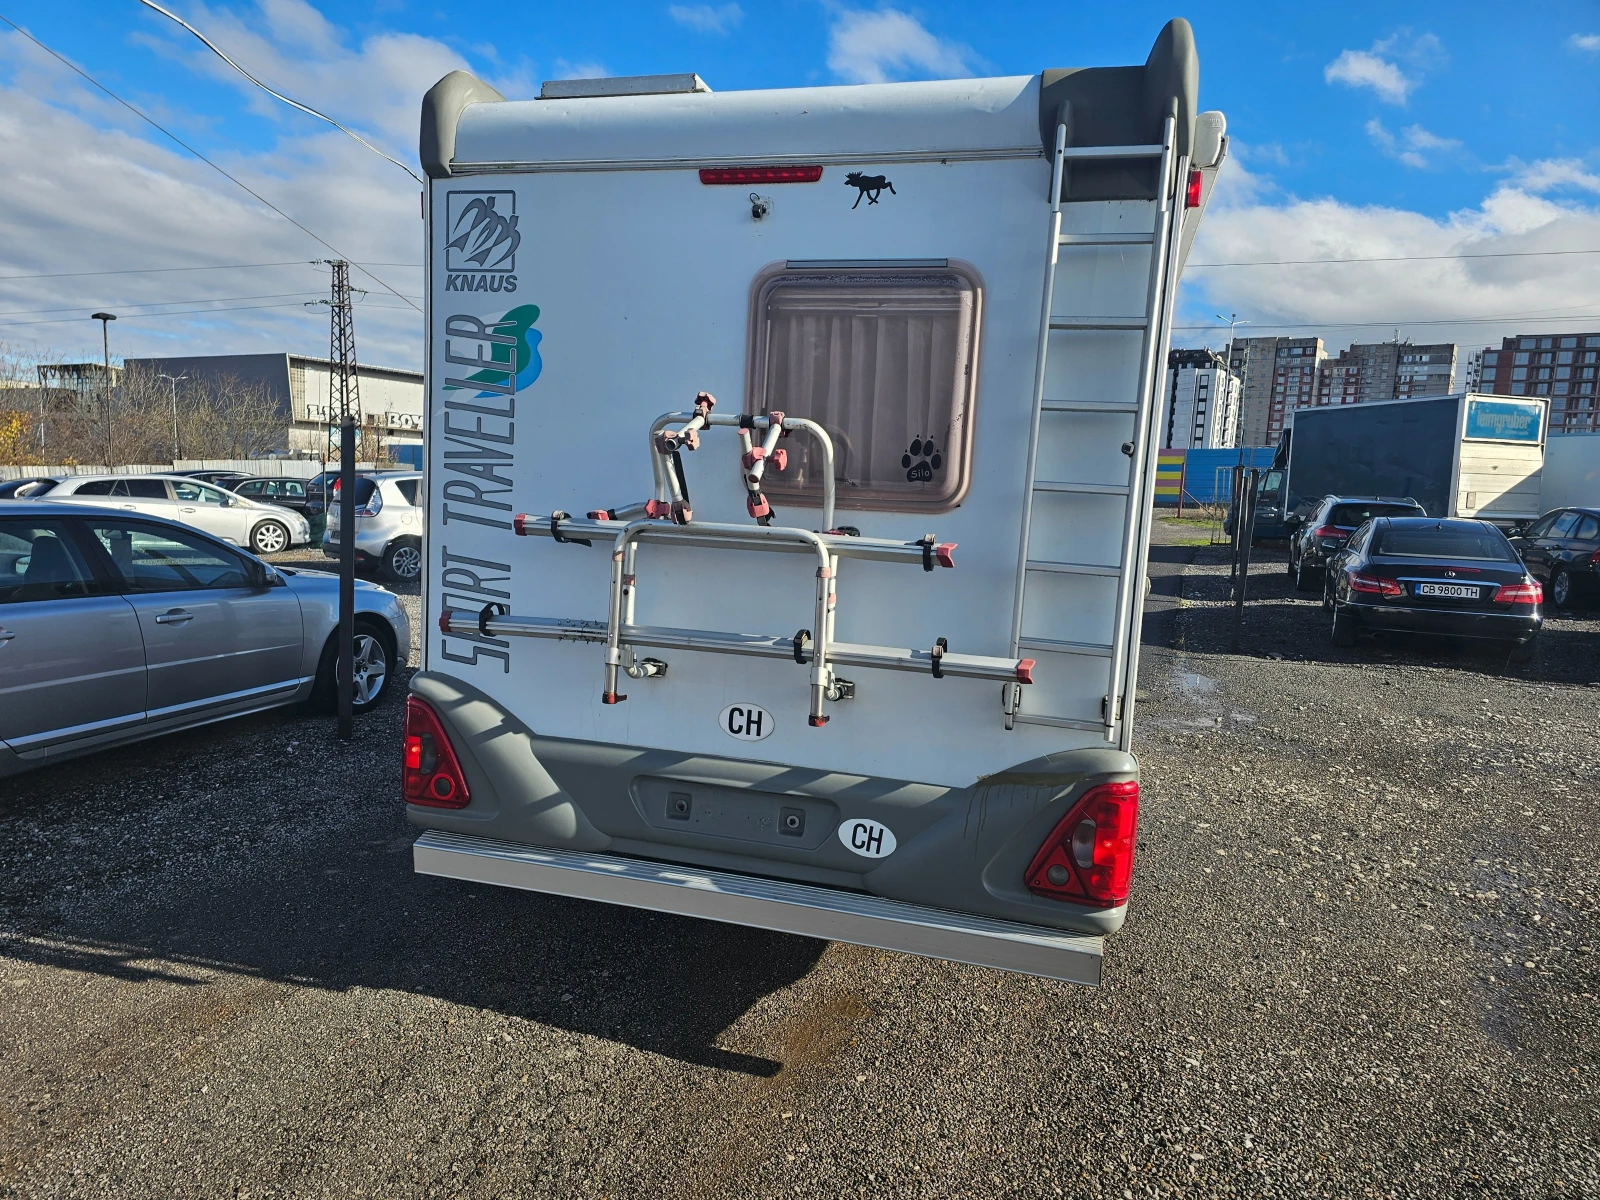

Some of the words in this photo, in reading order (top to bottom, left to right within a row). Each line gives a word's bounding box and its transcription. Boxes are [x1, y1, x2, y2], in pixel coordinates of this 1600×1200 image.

[445, 274, 518, 292] KNAUS
[443, 314, 517, 530] TRAVELLER
[1422, 585, 1436, 594] CB
[1438, 586, 1462, 596] 9800
[1464, 587, 1478, 597] TH
[728, 707, 763, 737] CH
[851, 823, 884, 854] CH
